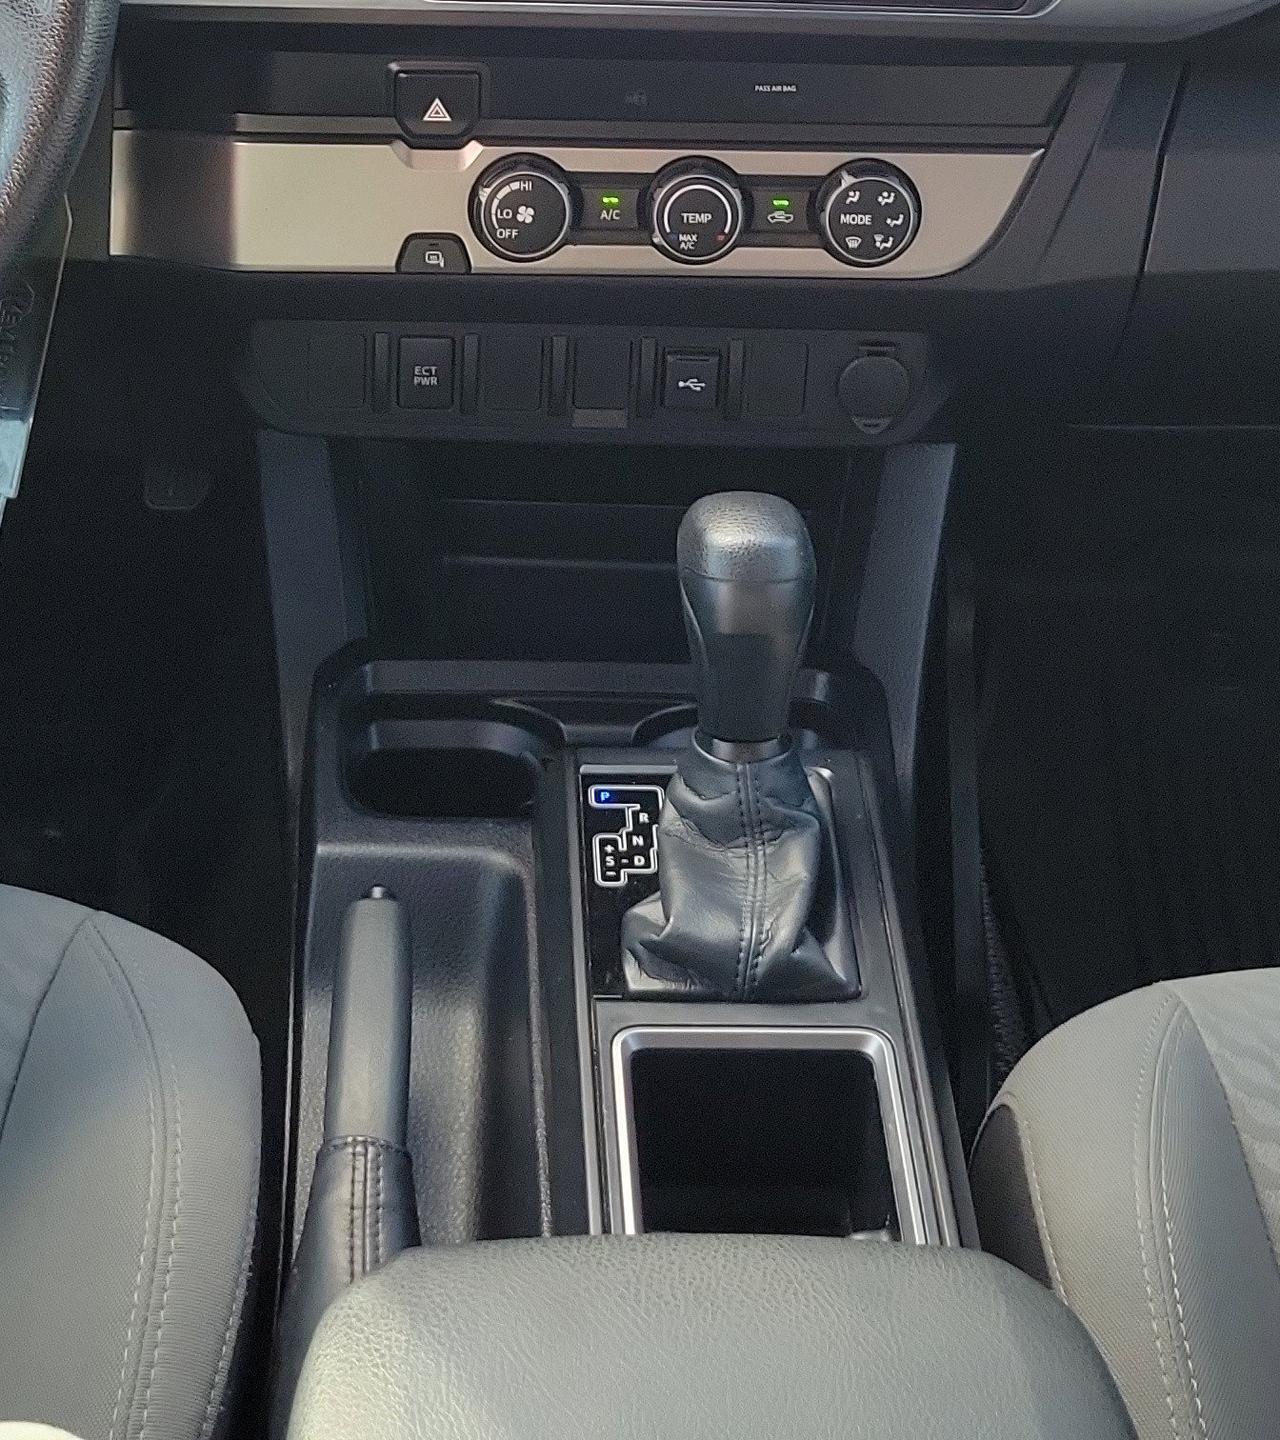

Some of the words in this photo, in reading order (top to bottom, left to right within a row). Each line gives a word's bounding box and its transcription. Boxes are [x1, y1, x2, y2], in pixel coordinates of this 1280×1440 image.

[520, 181, 533, 192] HI
[497, 208, 513, 219] LO
[600, 210, 621, 220] A/C
[681, 212, 712, 224] TEMP
[840, 214, 873, 226] MODE
[496, 228, 519, 239] OFF
[678, 233, 698, 242] MAX
[680, 242, 695, 250] A/C
[414, 366, 438, 376] ECT
[413, 376, 438, 386] PWR
[600, 791, 611, 801] P
[639, 812, 650, 823] R
[632, 835, 644, 846] N
[633, 855, 645, 866] D
